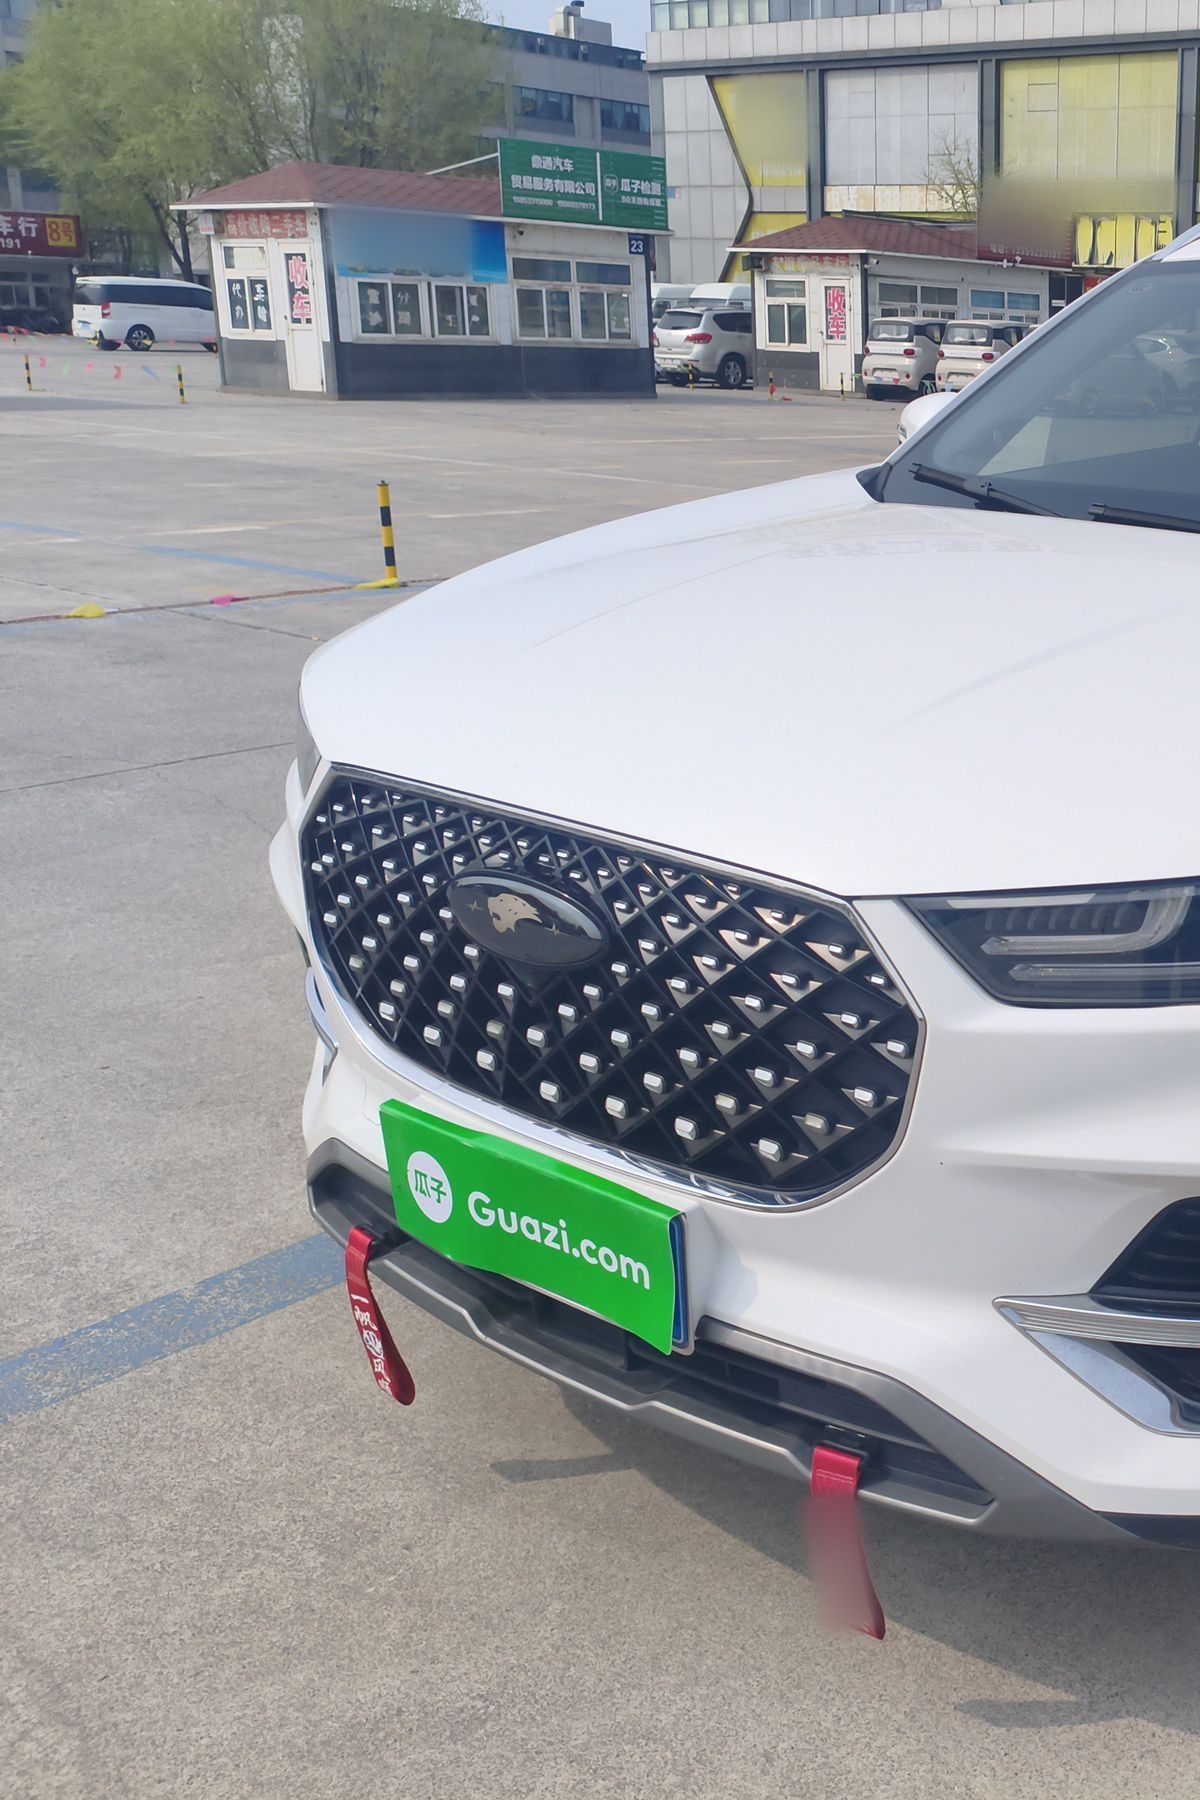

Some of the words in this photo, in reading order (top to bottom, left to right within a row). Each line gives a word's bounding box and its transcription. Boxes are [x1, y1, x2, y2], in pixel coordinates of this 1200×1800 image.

[511, 174, 596, 197] 贸易服务有限公司
[621, 178, 662, 196] 瓜子检测
[48, 221, 73, 242] 8号
[226, 213, 307, 237] 高价收购二手车
[630, 240, 644, 253] 23
[827, 287, 847, 341] 收车
[413, 1168, 447, 1204] 瓜子
[467, 1191, 650, 1290] Guazi.com
